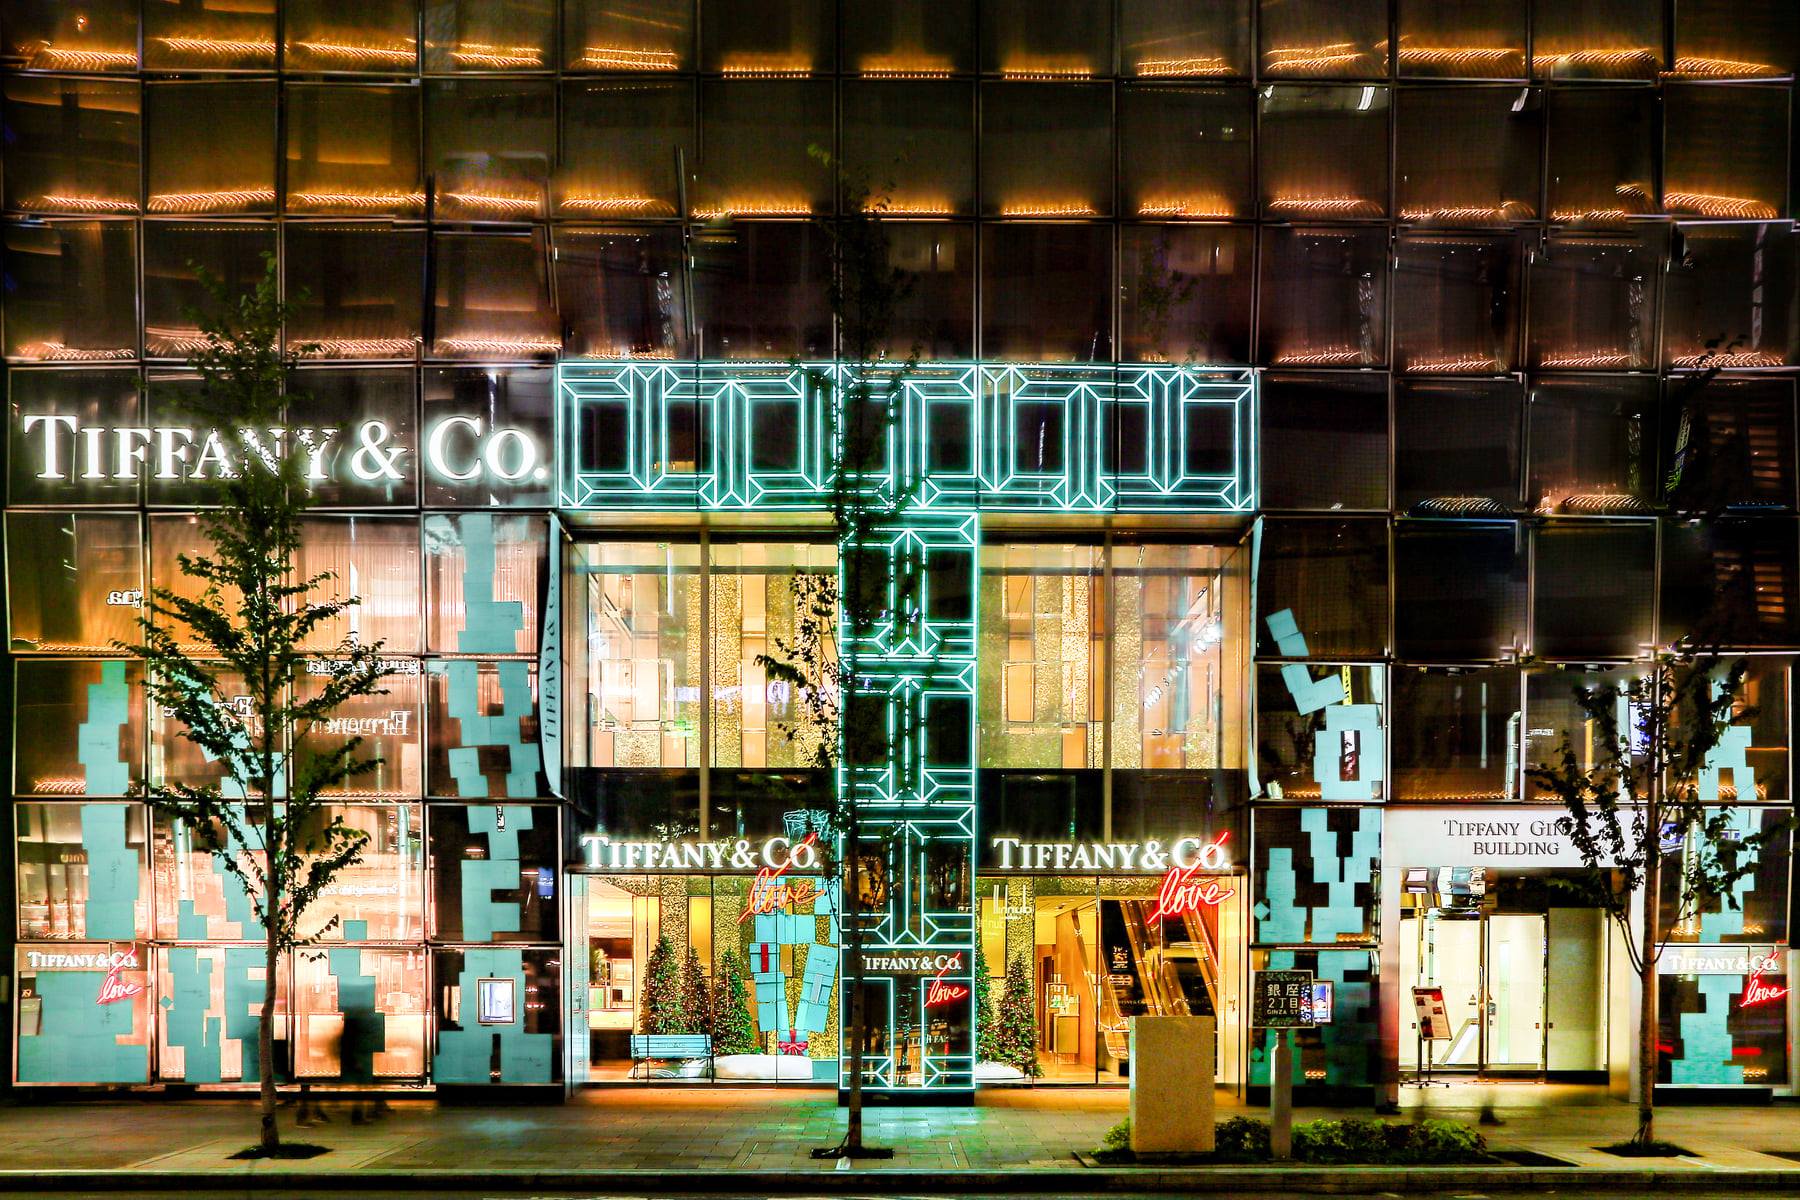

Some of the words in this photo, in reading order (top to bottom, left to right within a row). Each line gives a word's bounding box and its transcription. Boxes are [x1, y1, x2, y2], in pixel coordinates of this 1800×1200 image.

[351, 420, 408, 479] &
[1444, 820, 1520, 837] TIFFANY
[582, 836, 726, 868] TIFFANY
[731, 839, 758, 868] &
[993, 838, 1139, 869] TIFFANY
[1141, 841, 1169, 869] &
[1473, 841, 1560, 856] BUILDING
[737, 867, 825, 924] love
[1147, 867, 1234, 924] love
[27, 951, 95, 967] TIFFANY
[920, 957, 933, 970] &
[1668, 954, 1734, 971] TIFFANY
[96, 975, 142, 1004] love
[924, 979, 967, 1007] love
[1267, 983, 1299, 996] 銀座
[1268, 997, 1298, 1009] 2丁目
[1740, 979, 1792, 1007] love
